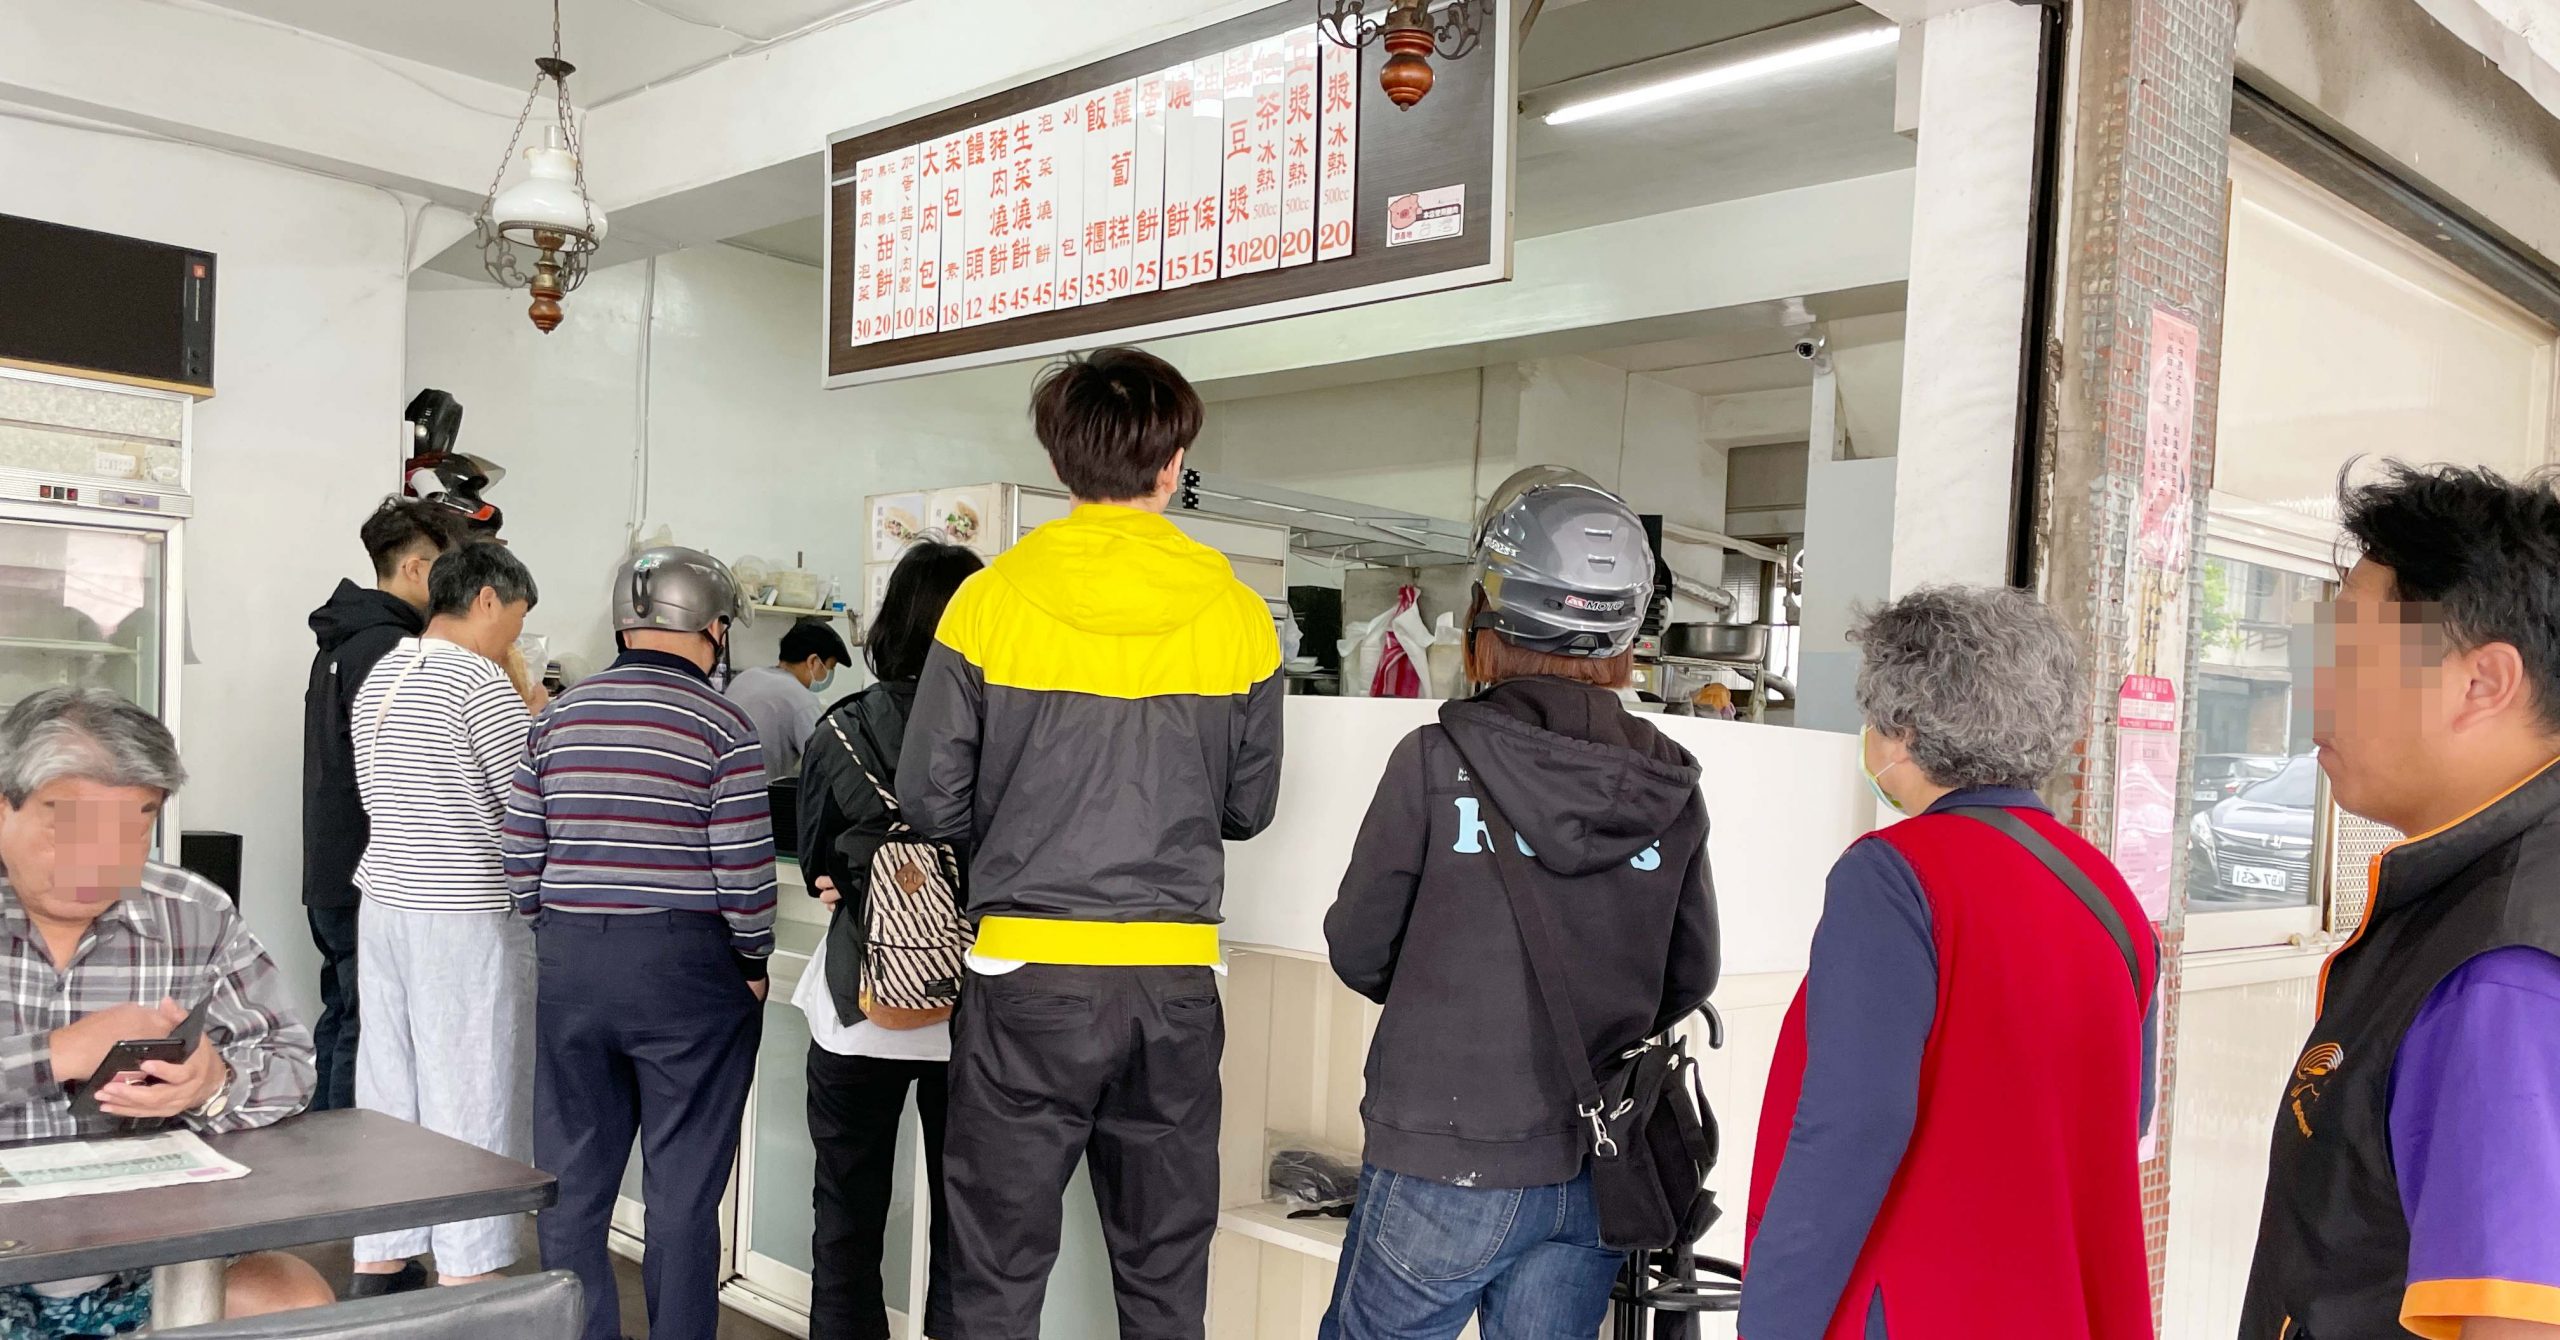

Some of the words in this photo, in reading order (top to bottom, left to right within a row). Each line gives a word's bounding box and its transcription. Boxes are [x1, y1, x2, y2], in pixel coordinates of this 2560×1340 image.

[1109, 88, 1133, 248] 蘿蔔糕
[1167, 73, 1192, 239] 燒餅
[1085, 96, 1108, 255] 飯糰
[989, 127, 1008, 276] 豬肉燒餅
[1011, 120, 1033, 270] 生菜燒餅
[1036, 114, 1054, 264] 泡菜燒餅
[1324, 188, 1350, 205] 500cc
[919, 147, 940, 289] 大肉包
[966, 132, 985, 282] 饅頭
[1253, 202, 1278, 219] 500cc
[1285, 199, 1310, 215] 500cc
[1282, 229, 1311, 256] 20
[1320, 220, 1350, 249] 20
[1225, 244, 1248, 269] 30
[1249, 234, 1277, 262] 20
[1135, 260, 1156, 286] 25
[1166, 256, 1188, 281] 15
[1191, 250, 1214, 275] 15
[1059, 278, 1077, 300] 45
[1085, 274, 1105, 297] 35
[1108, 267, 1128, 292] 30
[989, 292, 1007, 314] 45
[1010, 287, 1029, 309] 45
[1033, 283, 1052, 305] 45
[895, 307, 914, 329] 10
[918, 305, 934, 327] 18
[944, 303, 959, 324] 18
[966, 297, 982, 320] 12
[855, 318, 871, 340] 30
[874, 314, 891, 335] 20
[1585, 600, 1625, 612] MOTO
